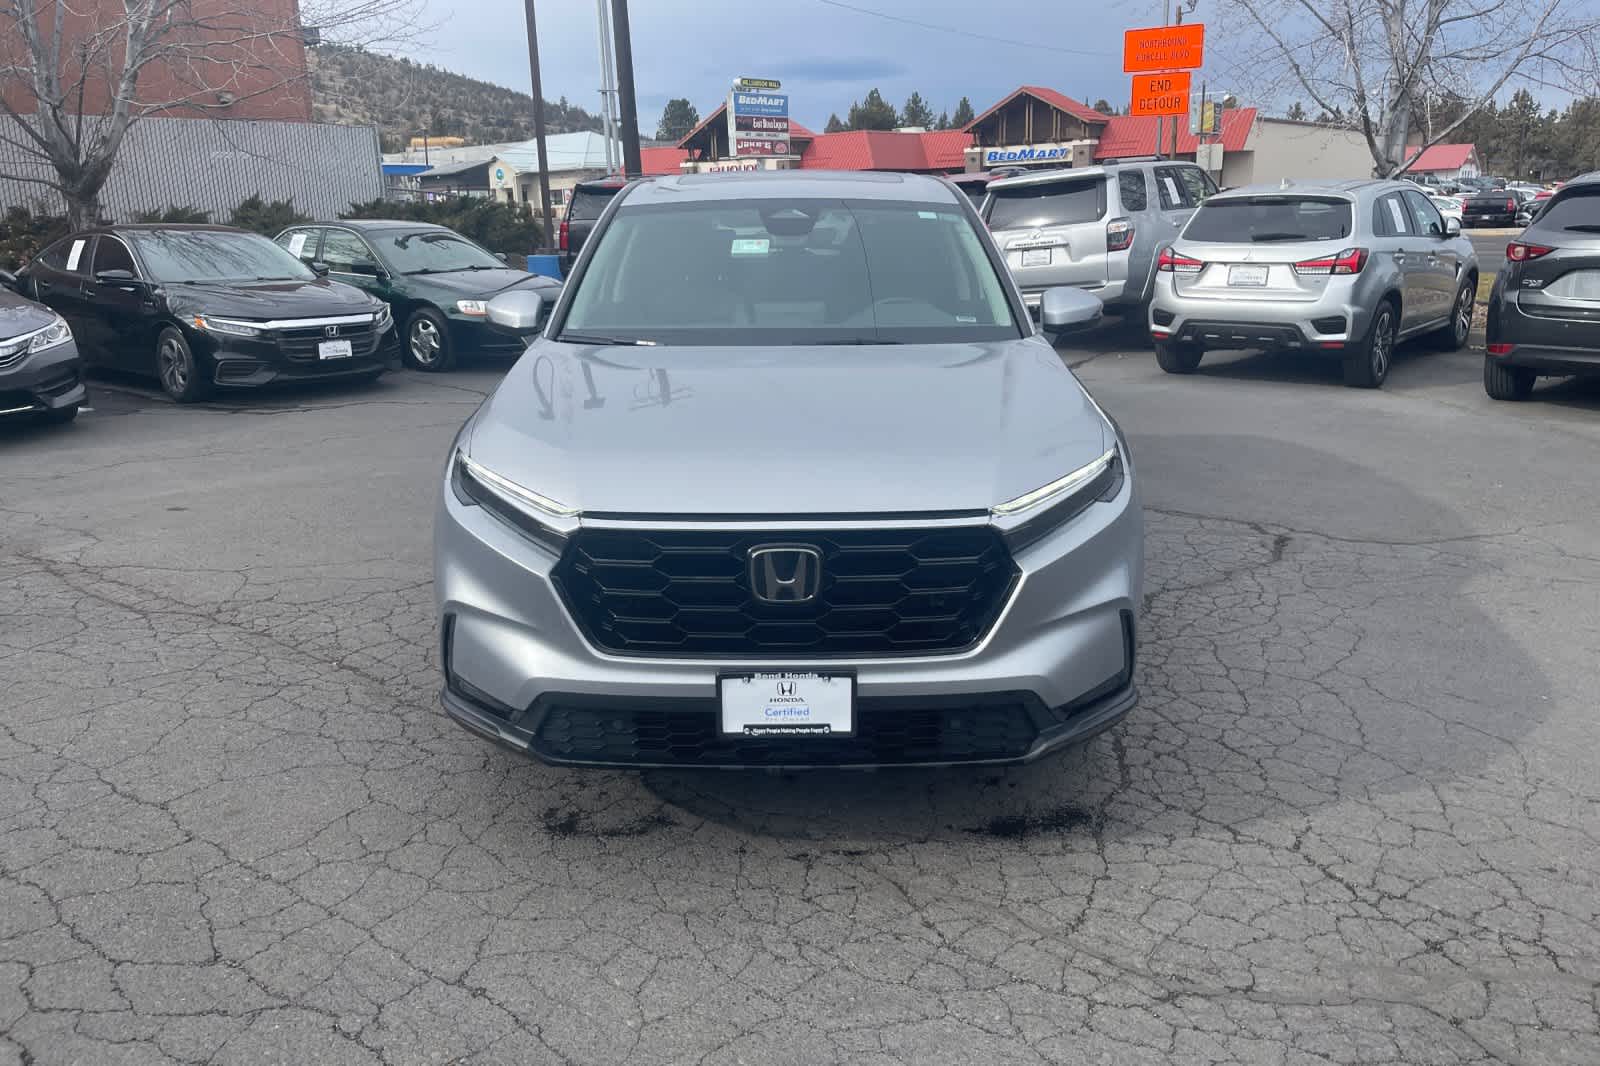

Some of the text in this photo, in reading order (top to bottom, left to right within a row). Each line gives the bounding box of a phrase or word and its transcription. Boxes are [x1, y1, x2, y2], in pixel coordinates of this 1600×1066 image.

[1150, 80, 1172, 92] END
[1139, 96, 1181, 110] DETOUR
[764, 707, 810, 717] Certified
